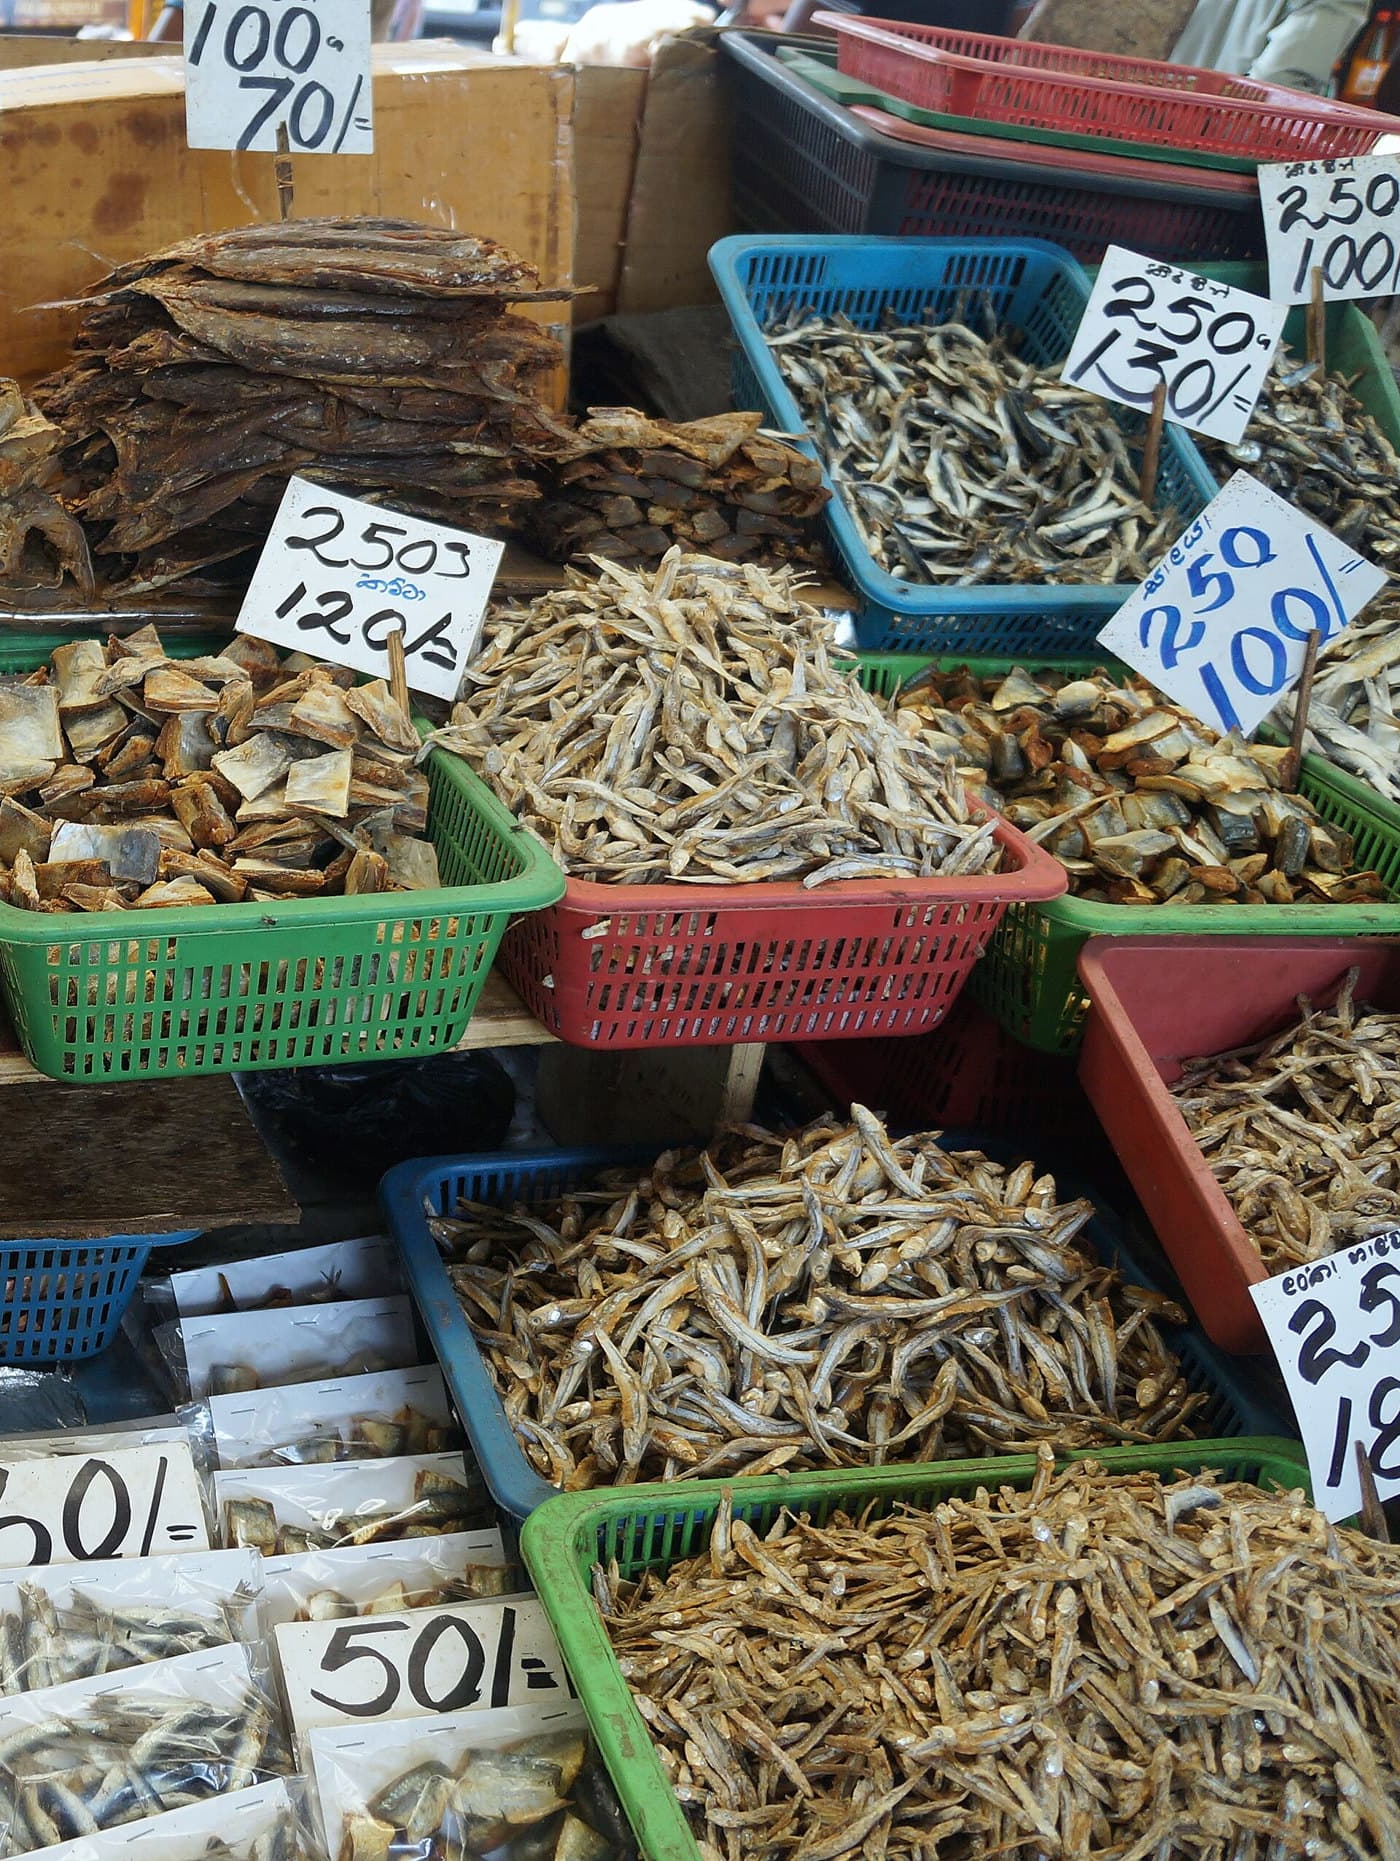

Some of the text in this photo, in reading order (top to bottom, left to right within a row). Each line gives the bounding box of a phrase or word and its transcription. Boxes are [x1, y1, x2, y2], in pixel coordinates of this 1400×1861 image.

[236, 73, 373, 154] 70/=
[1277, 173, 1400, 233] 250
[1069, 328, 1252, 426] 130/=
[1139, 526, 1278, 670] 250
[1198, 533, 1365, 731] 100/=
[310, 1606, 559, 1717] 50/=
